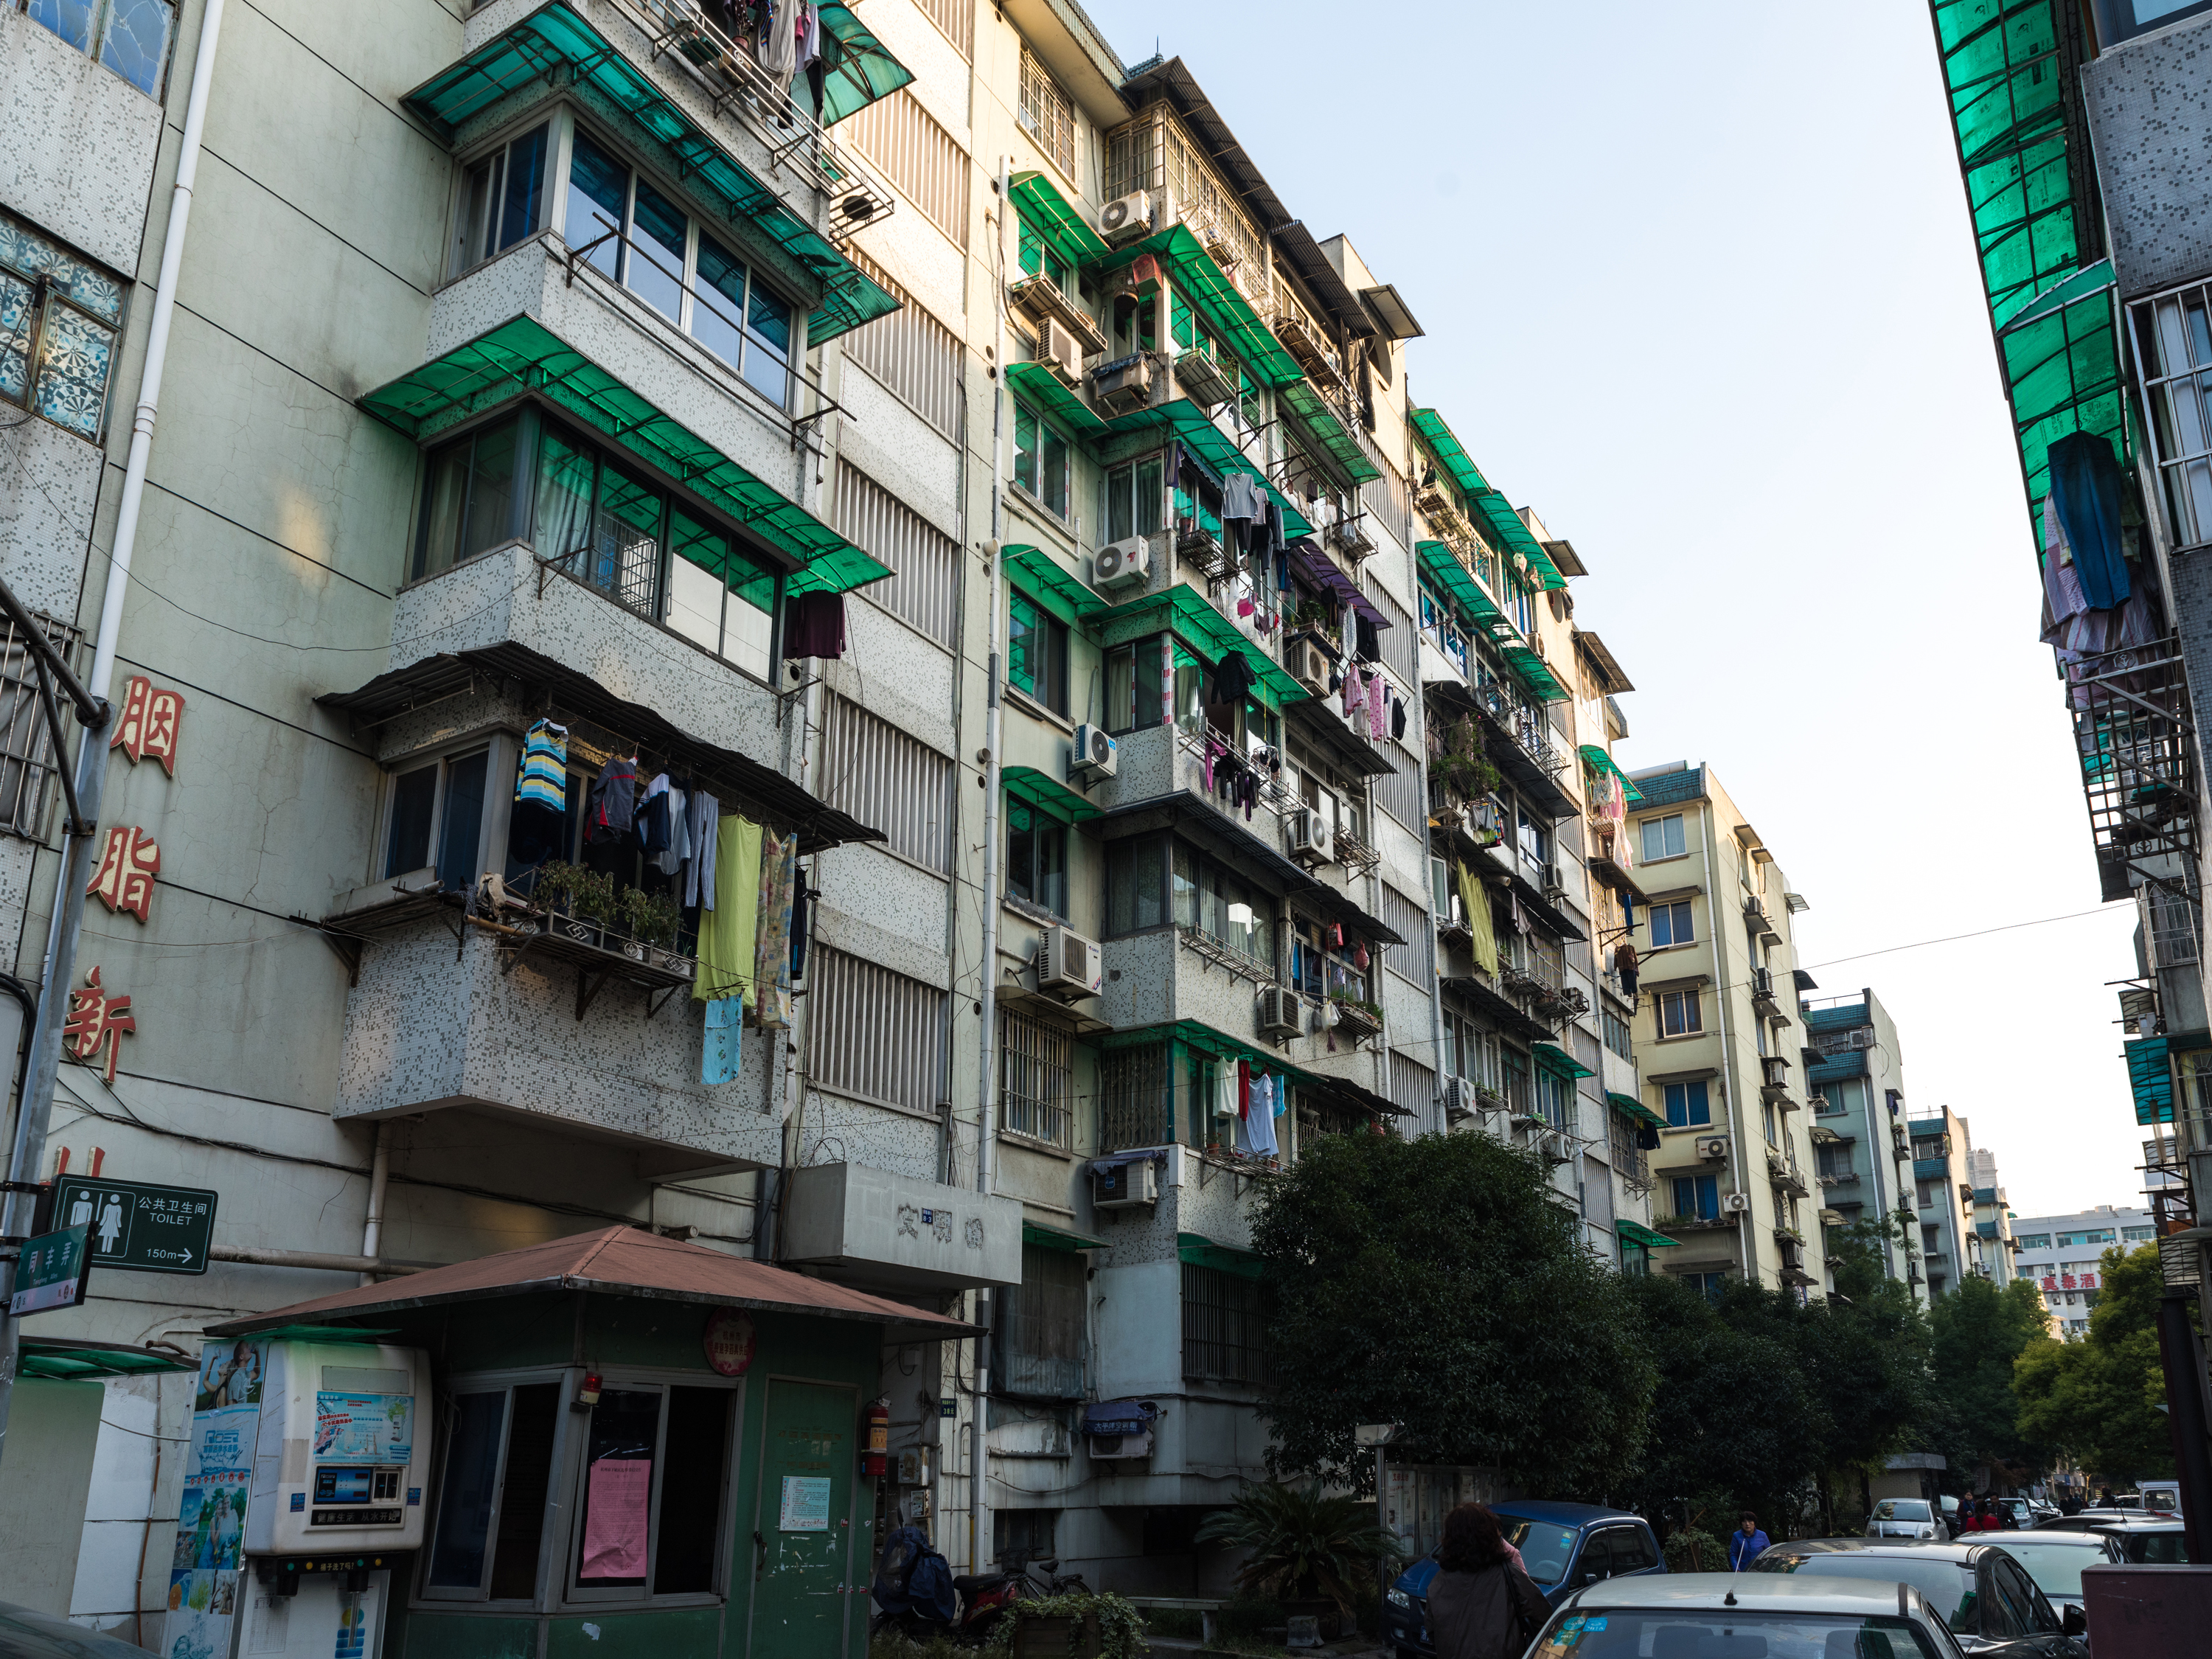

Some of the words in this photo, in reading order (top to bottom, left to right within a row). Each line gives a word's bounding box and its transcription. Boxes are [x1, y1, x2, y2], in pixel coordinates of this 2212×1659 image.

[0, 332, 29, 354] CO
[138, 1196, 207, 1216] 公共卫生间
[149, 1212, 192, 1225] TOILET
[27, 1242, 72, 1274] 同丰弄
[146, 1248, 177, 1260] 150m
[2041, 1273, 2104, 1292] 莫泰酒
[723, 1330, 741, 1341] 杭州市
[317, 1512, 355, 1523] 健康生活
